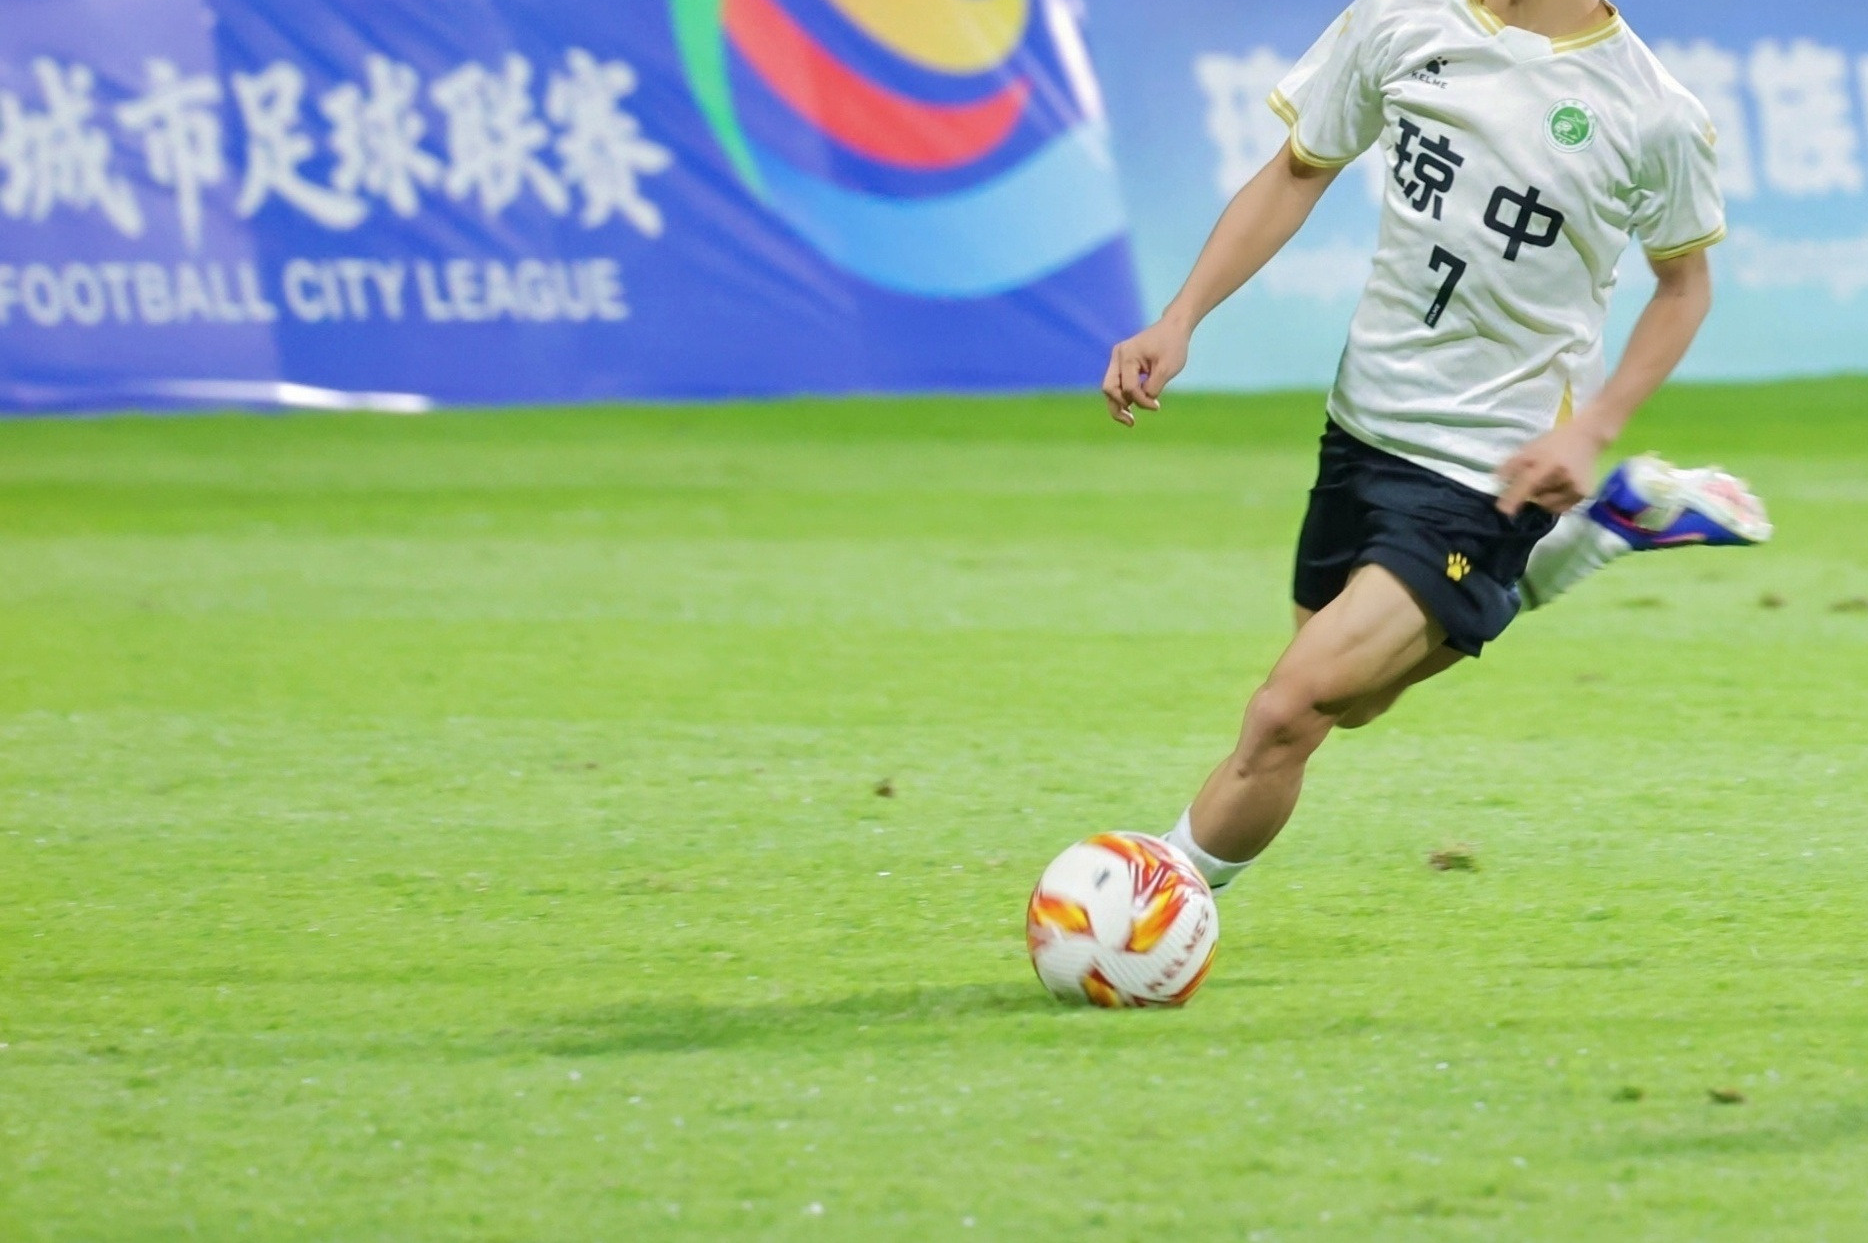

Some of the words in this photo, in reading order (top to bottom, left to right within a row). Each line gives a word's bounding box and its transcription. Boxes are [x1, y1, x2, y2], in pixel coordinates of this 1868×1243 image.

[1411, 70, 1448, 89] KELME
[0, 47, 672, 249] 城市足球联赛
[1393, 117, 1565, 262] 琼中
[283, 257, 405, 323] CITY
[415, 257, 630, 323] LEAGUE
[1424, 244, 1467, 329] 7
